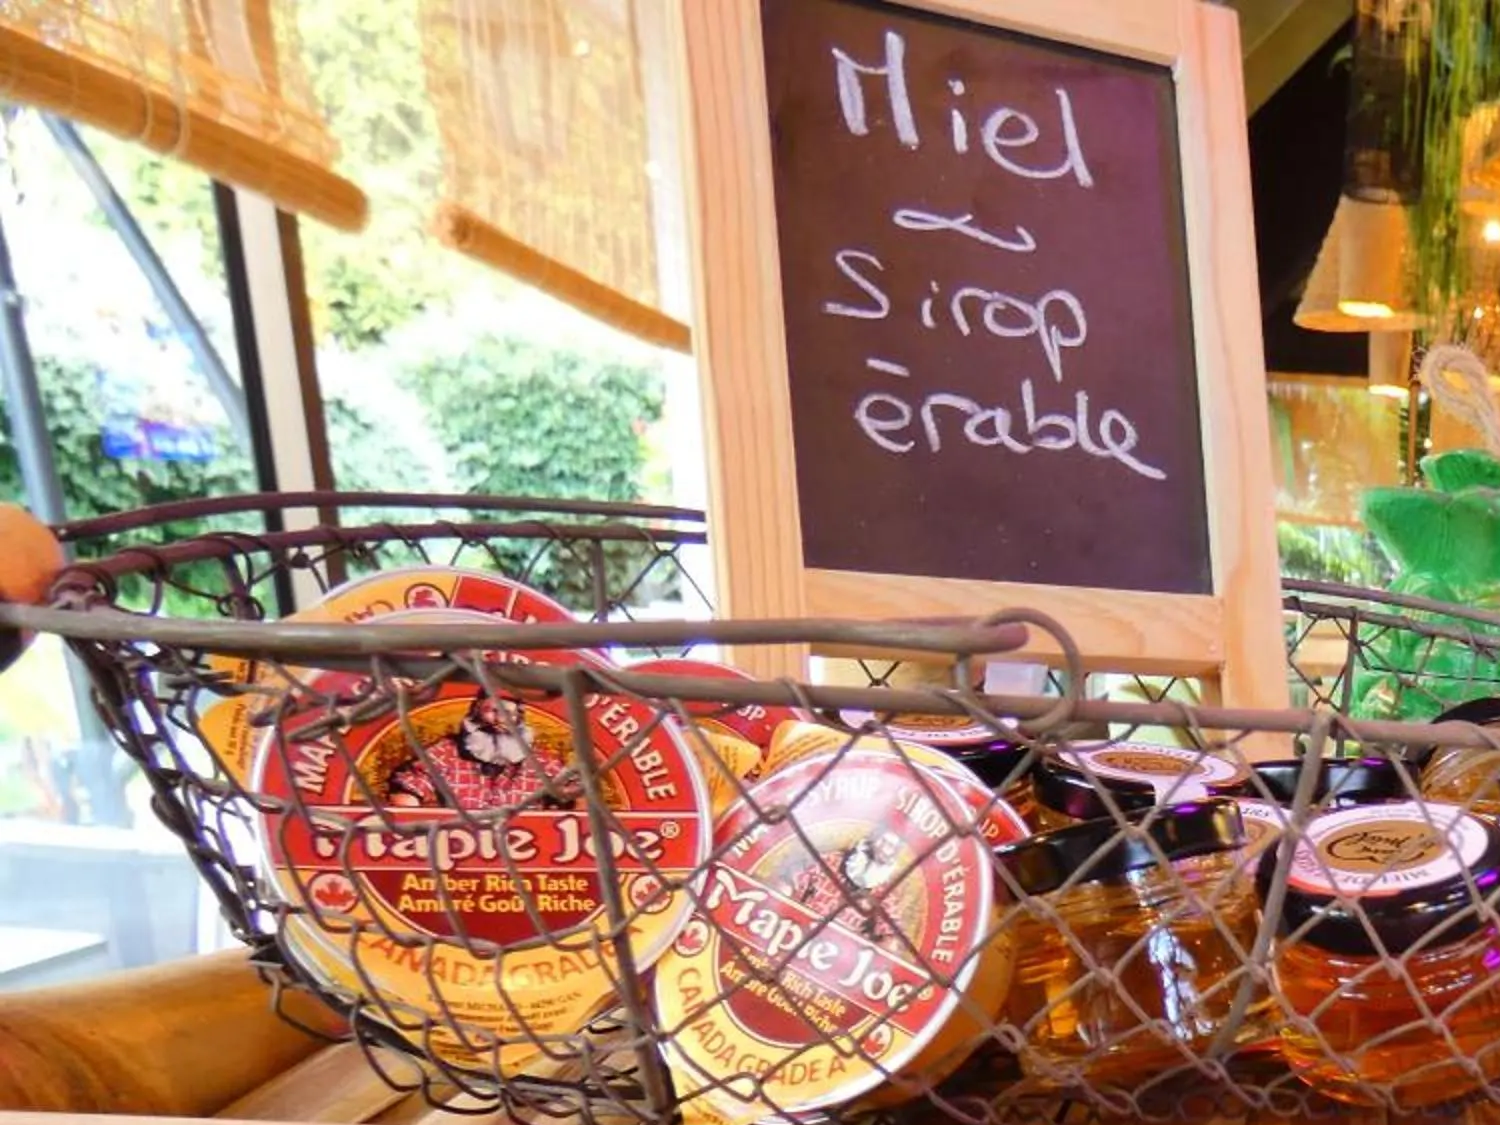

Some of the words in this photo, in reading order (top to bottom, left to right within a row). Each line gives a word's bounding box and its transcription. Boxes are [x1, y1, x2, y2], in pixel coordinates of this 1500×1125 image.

[831, 30, 1094, 188] Miel
[821, 249, 1089, 383] Sirop
[398, 894, 476, 913] Amré
[479, 894, 526, 913] Goû
[538, 894, 596, 912] Riche
[536, 873, 590, 892] Taste
[352, 918, 502, 986] ANADA
